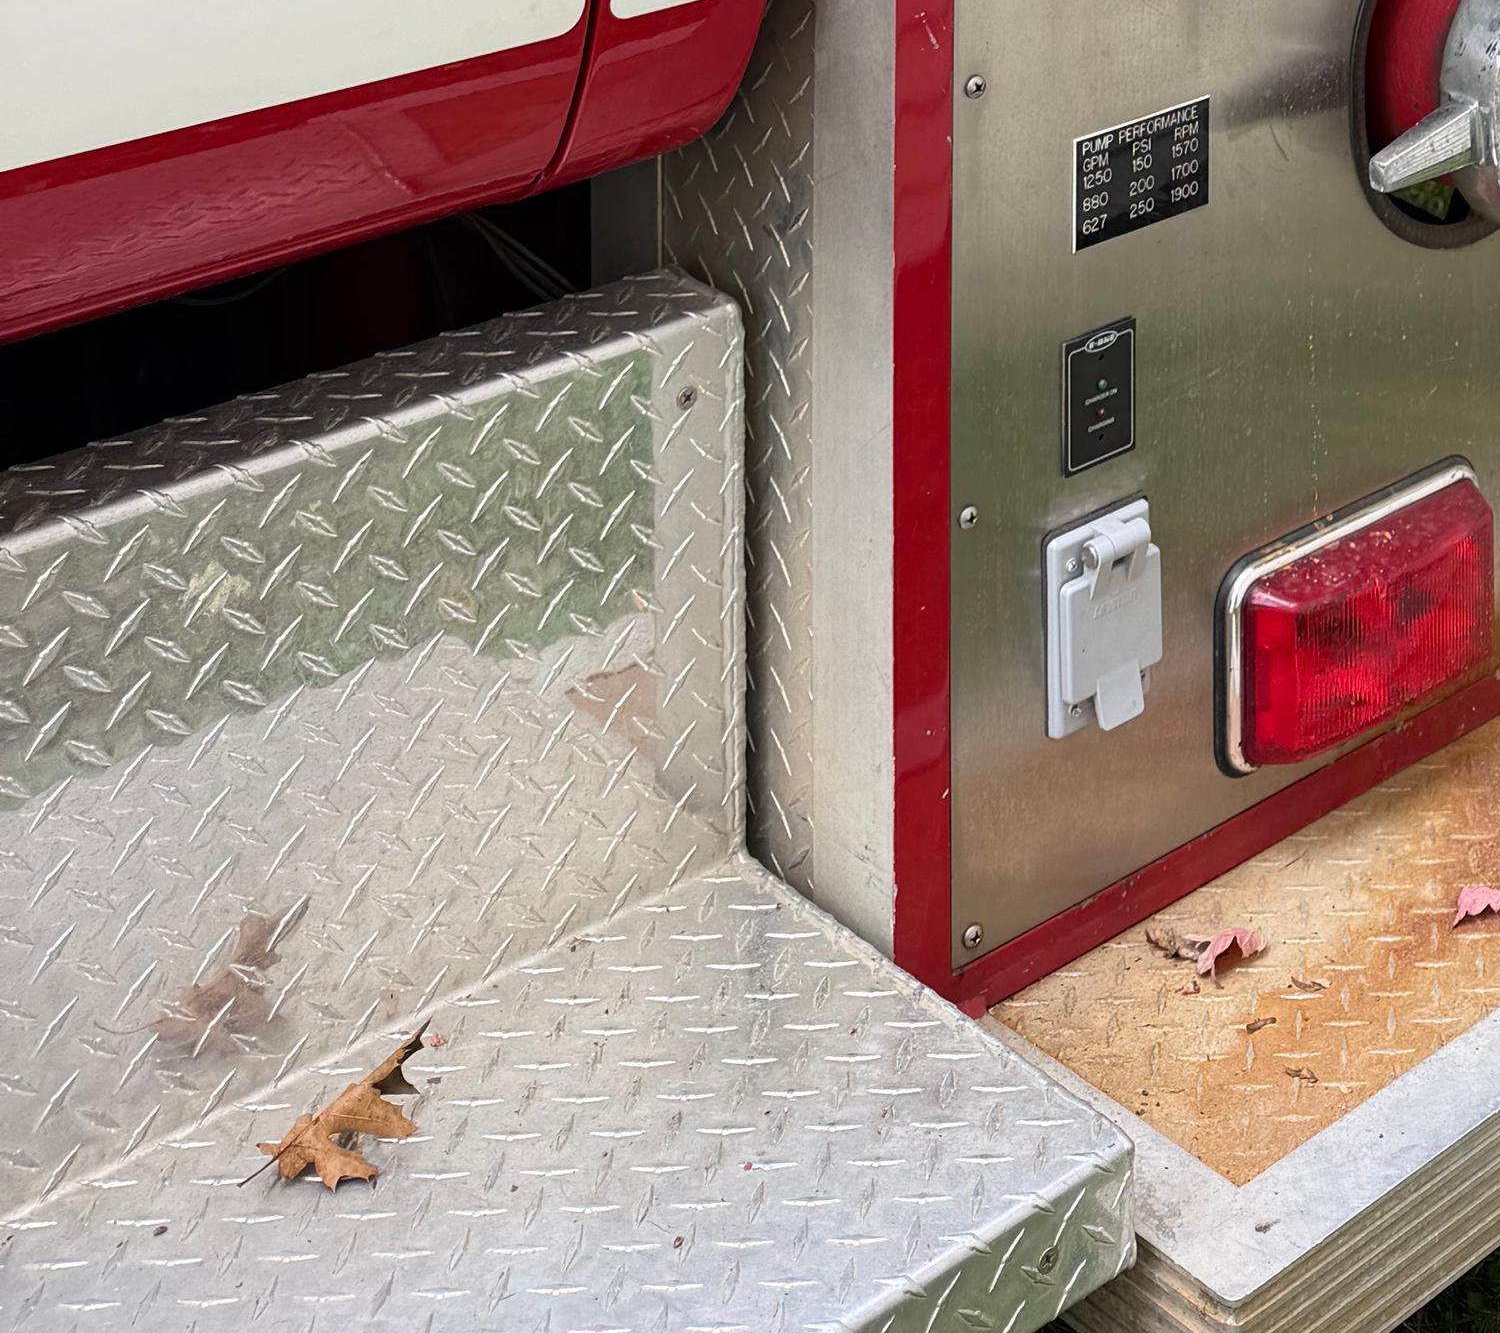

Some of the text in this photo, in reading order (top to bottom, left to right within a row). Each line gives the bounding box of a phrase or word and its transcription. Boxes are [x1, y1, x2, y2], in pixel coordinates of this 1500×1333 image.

[1082, 105, 1198, 155] PUMP PERFORMANCE
[1083, 121, 1199, 172] GPM PSI RPM
[1083, 159, 1198, 212] 880 200 1700
[1084, 138, 1198, 189] 1250 150 1570
[1082, 181, 1198, 234] 627 250 1900
